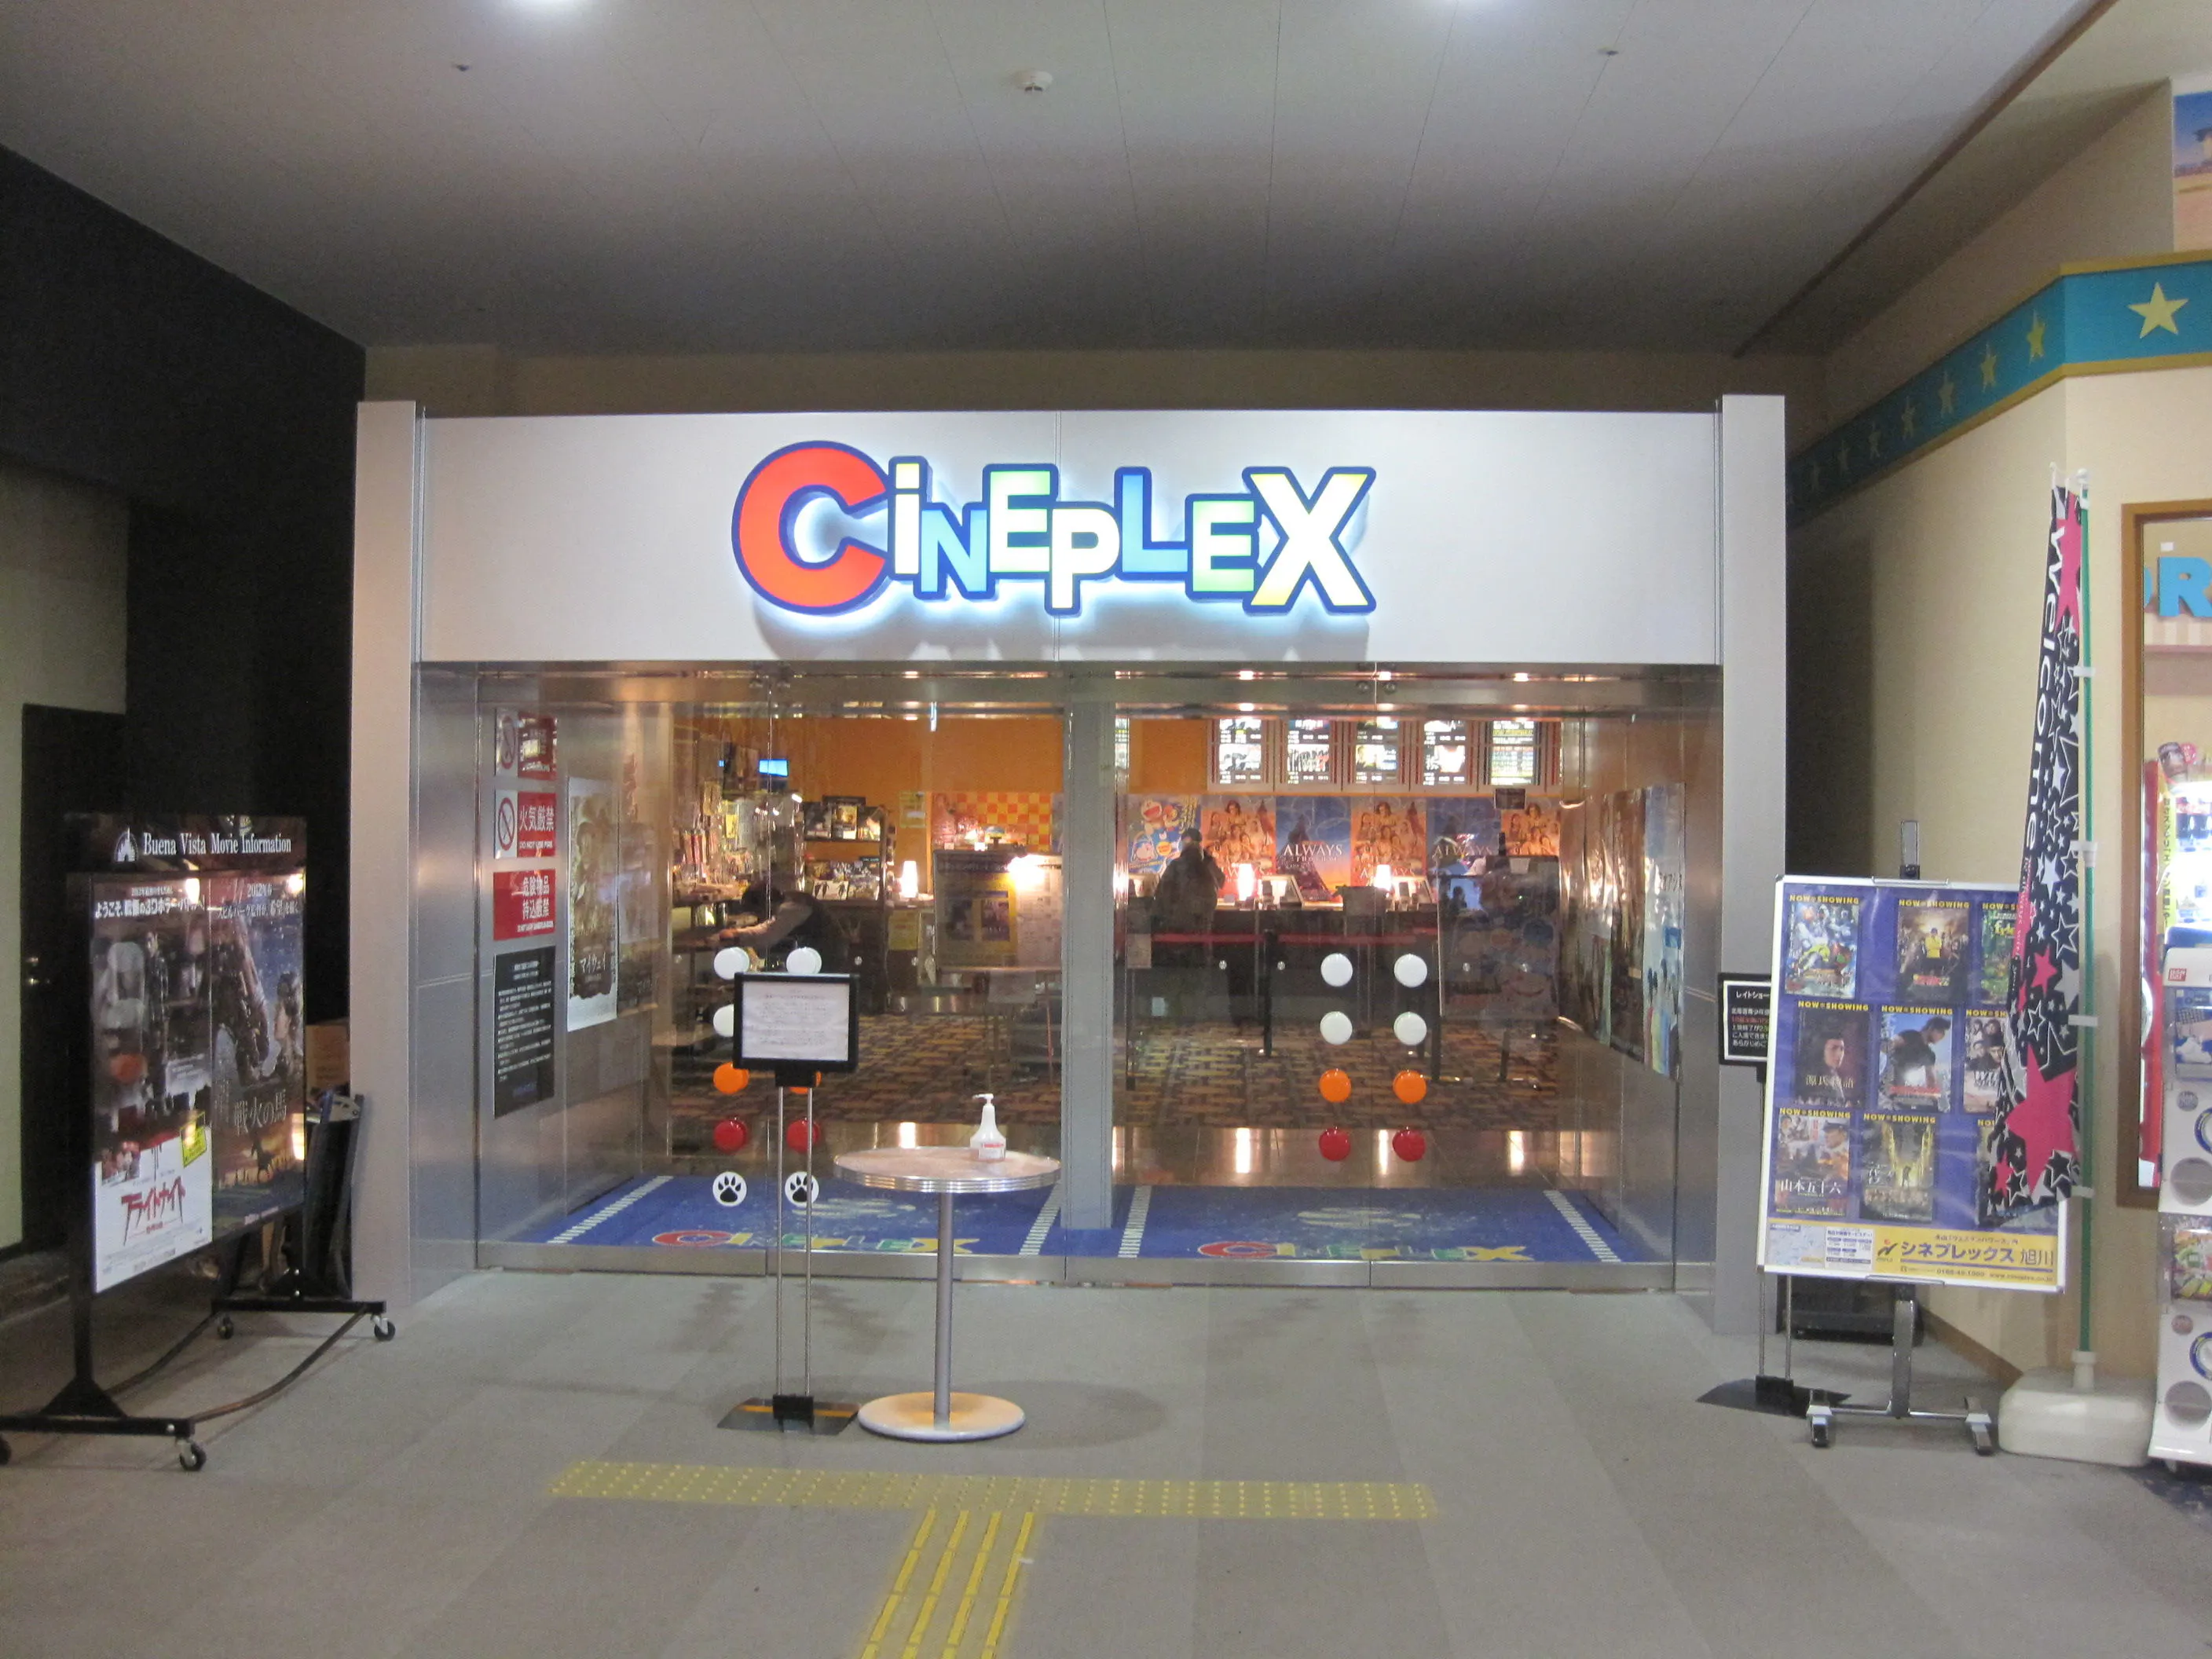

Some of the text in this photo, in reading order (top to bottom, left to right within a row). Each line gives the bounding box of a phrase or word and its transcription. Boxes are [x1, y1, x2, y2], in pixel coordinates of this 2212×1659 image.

[144, 832, 291, 855] Buena Vista Movie Information
[1284, 844, 1342, 856] ALWAYS
[1927, 900, 1970, 909] SHOWING
[1826, 1002, 1869, 1011] SHOWING
[1808, 1110, 1851, 1119] SHOWING
[1892, 1115, 1936, 1123] SHOWING
[1901, 1241, 2054, 1266] シネプレックス 旭川
